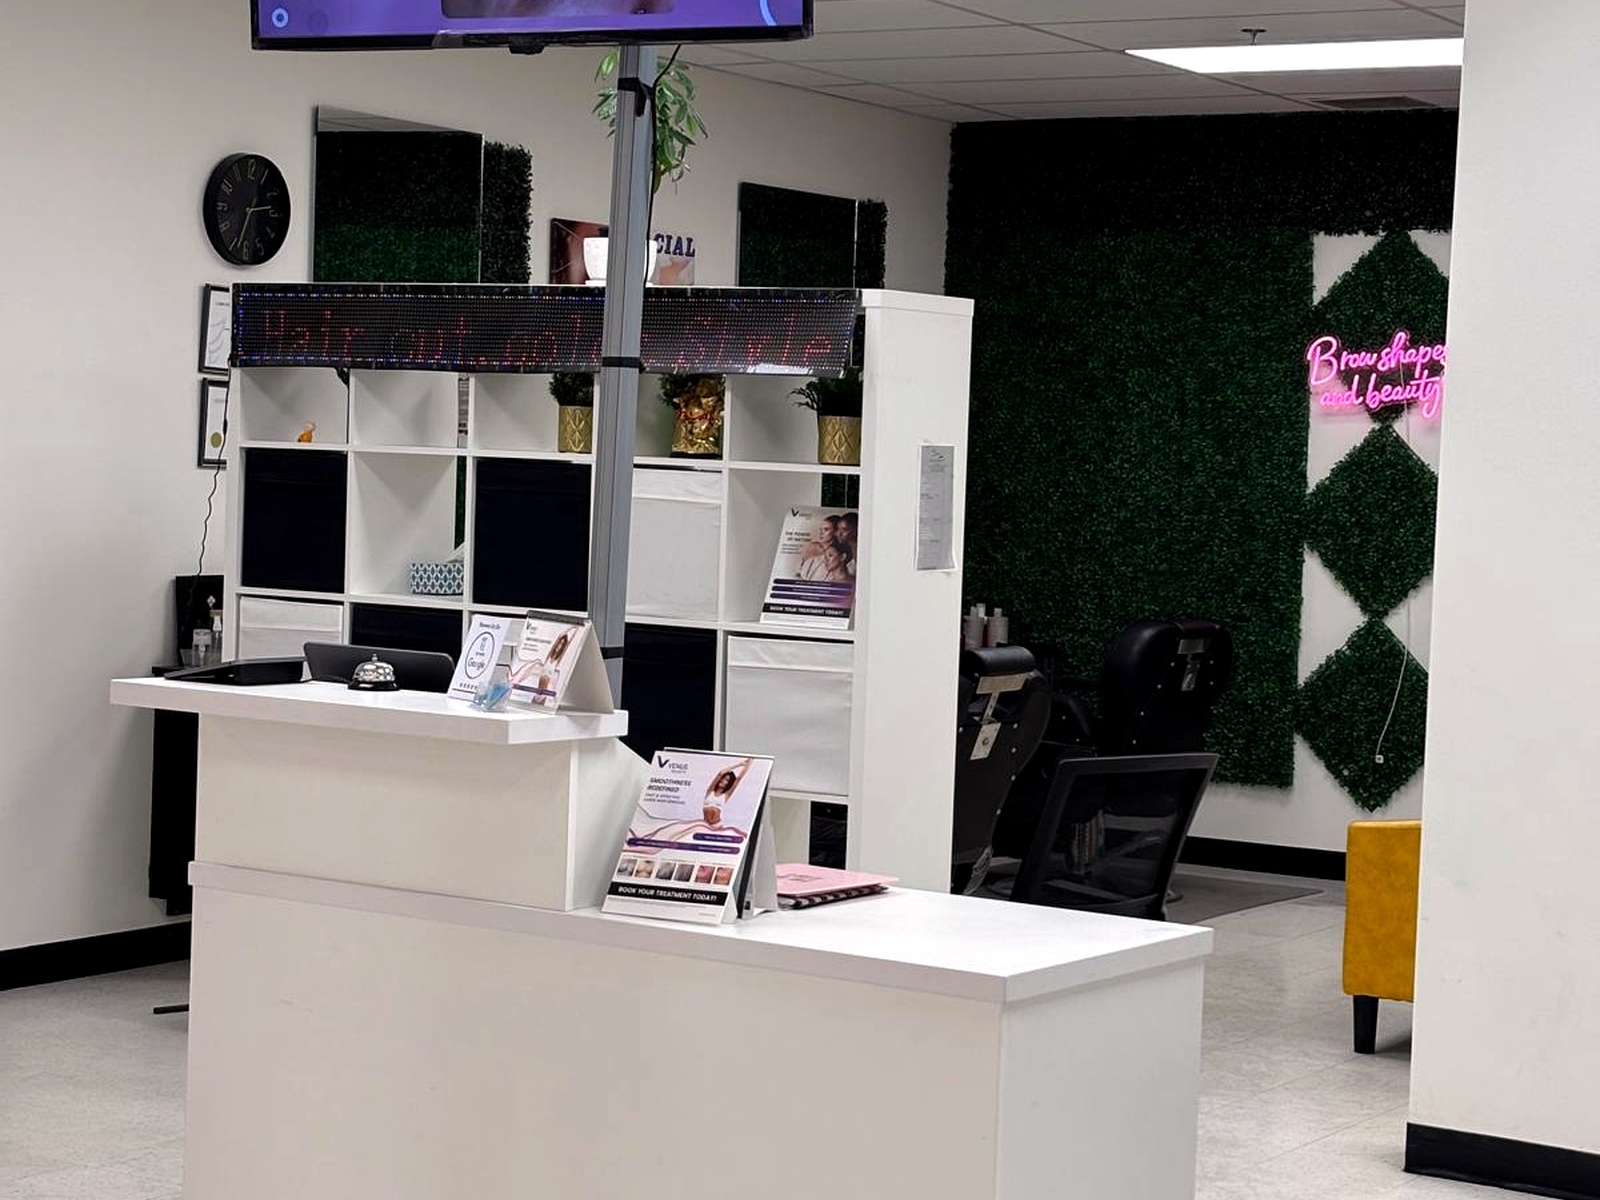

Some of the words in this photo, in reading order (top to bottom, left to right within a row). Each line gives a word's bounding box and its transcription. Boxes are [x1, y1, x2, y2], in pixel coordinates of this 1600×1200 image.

[654, 233, 696, 258] CIAL
[1307, 336, 1379, 385] Brow
[1320, 374, 1364, 405] and
[1365, 369, 1442, 419] beauty
[618, 886, 637, 894] BOOK
[637, 887, 655, 896] YOUR
[655, 888, 693, 900] TREATMENT
